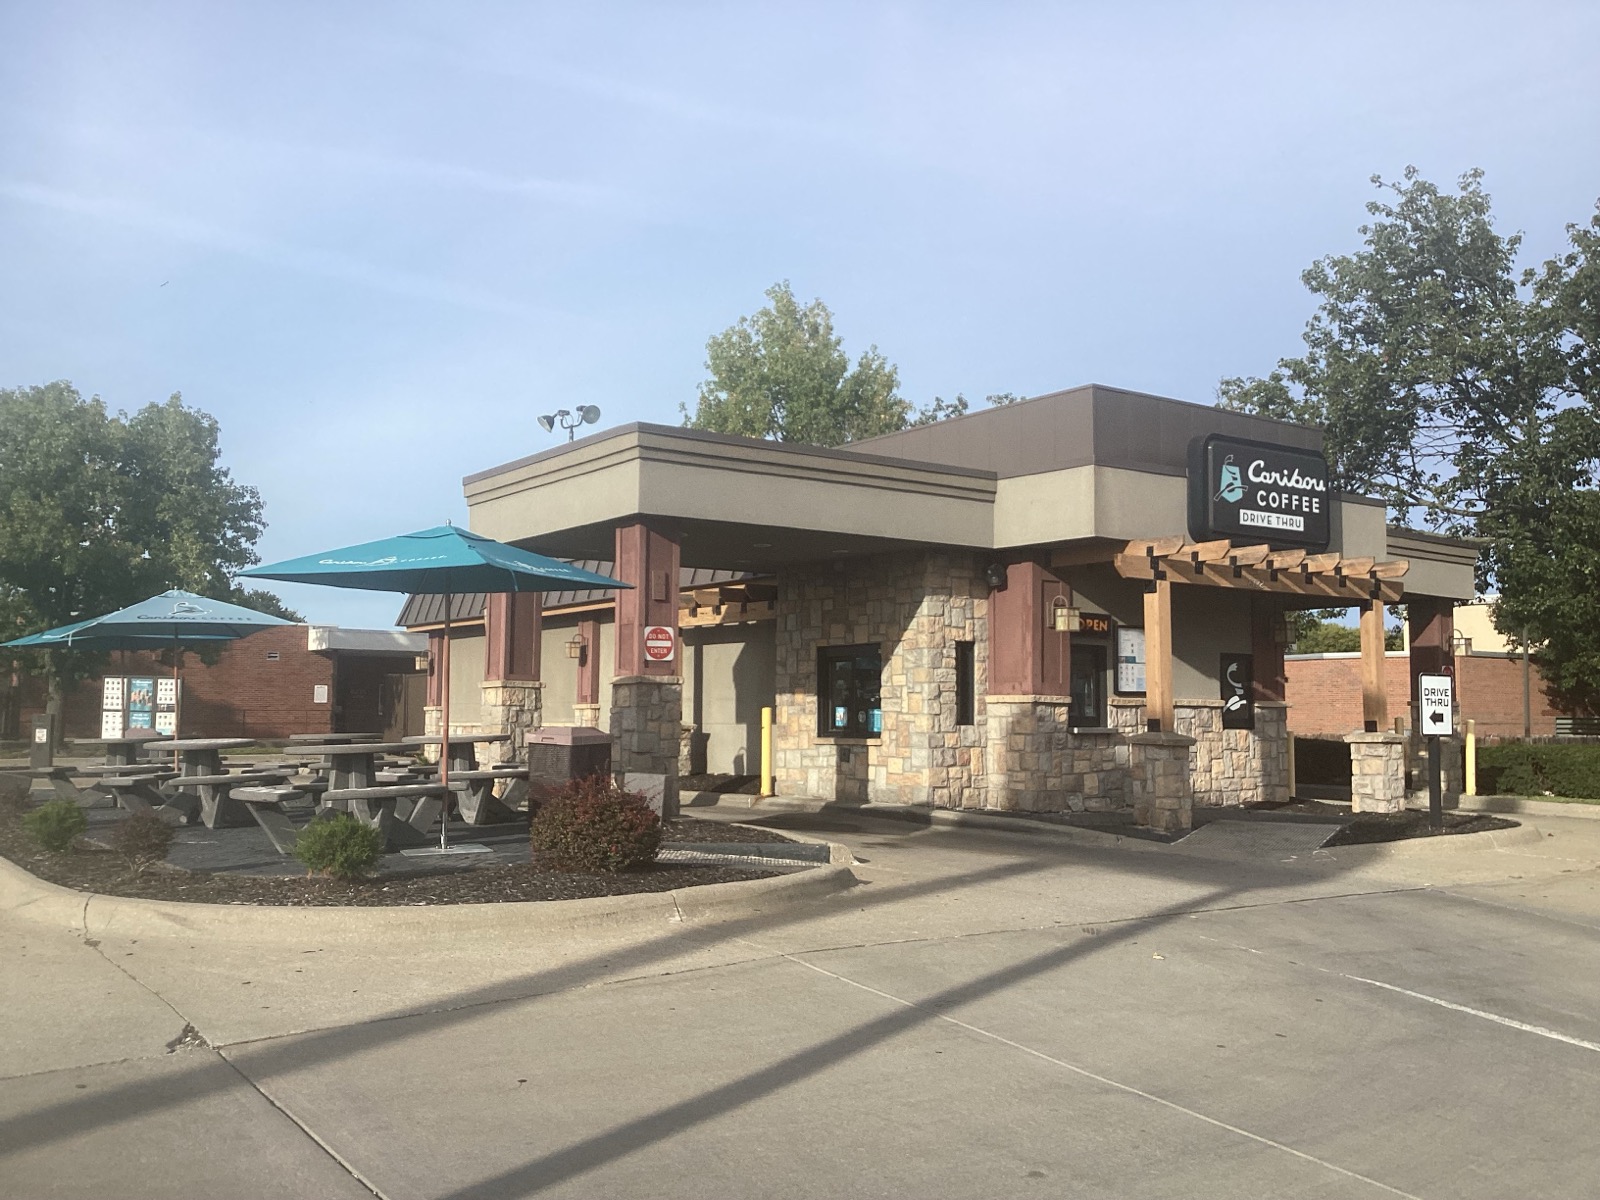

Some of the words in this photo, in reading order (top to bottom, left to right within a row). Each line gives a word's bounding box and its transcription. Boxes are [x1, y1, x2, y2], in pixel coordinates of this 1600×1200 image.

[1248, 460, 1325, 491] Caribou
[1257, 490, 1320, 513] COFFEE
[1242, 512, 1272, 525] DRIVE
[1276, 516, 1301, 528] THRU
[1424, 687, 1449, 697] DRIVE
[1425, 698, 1449, 707] THRU
